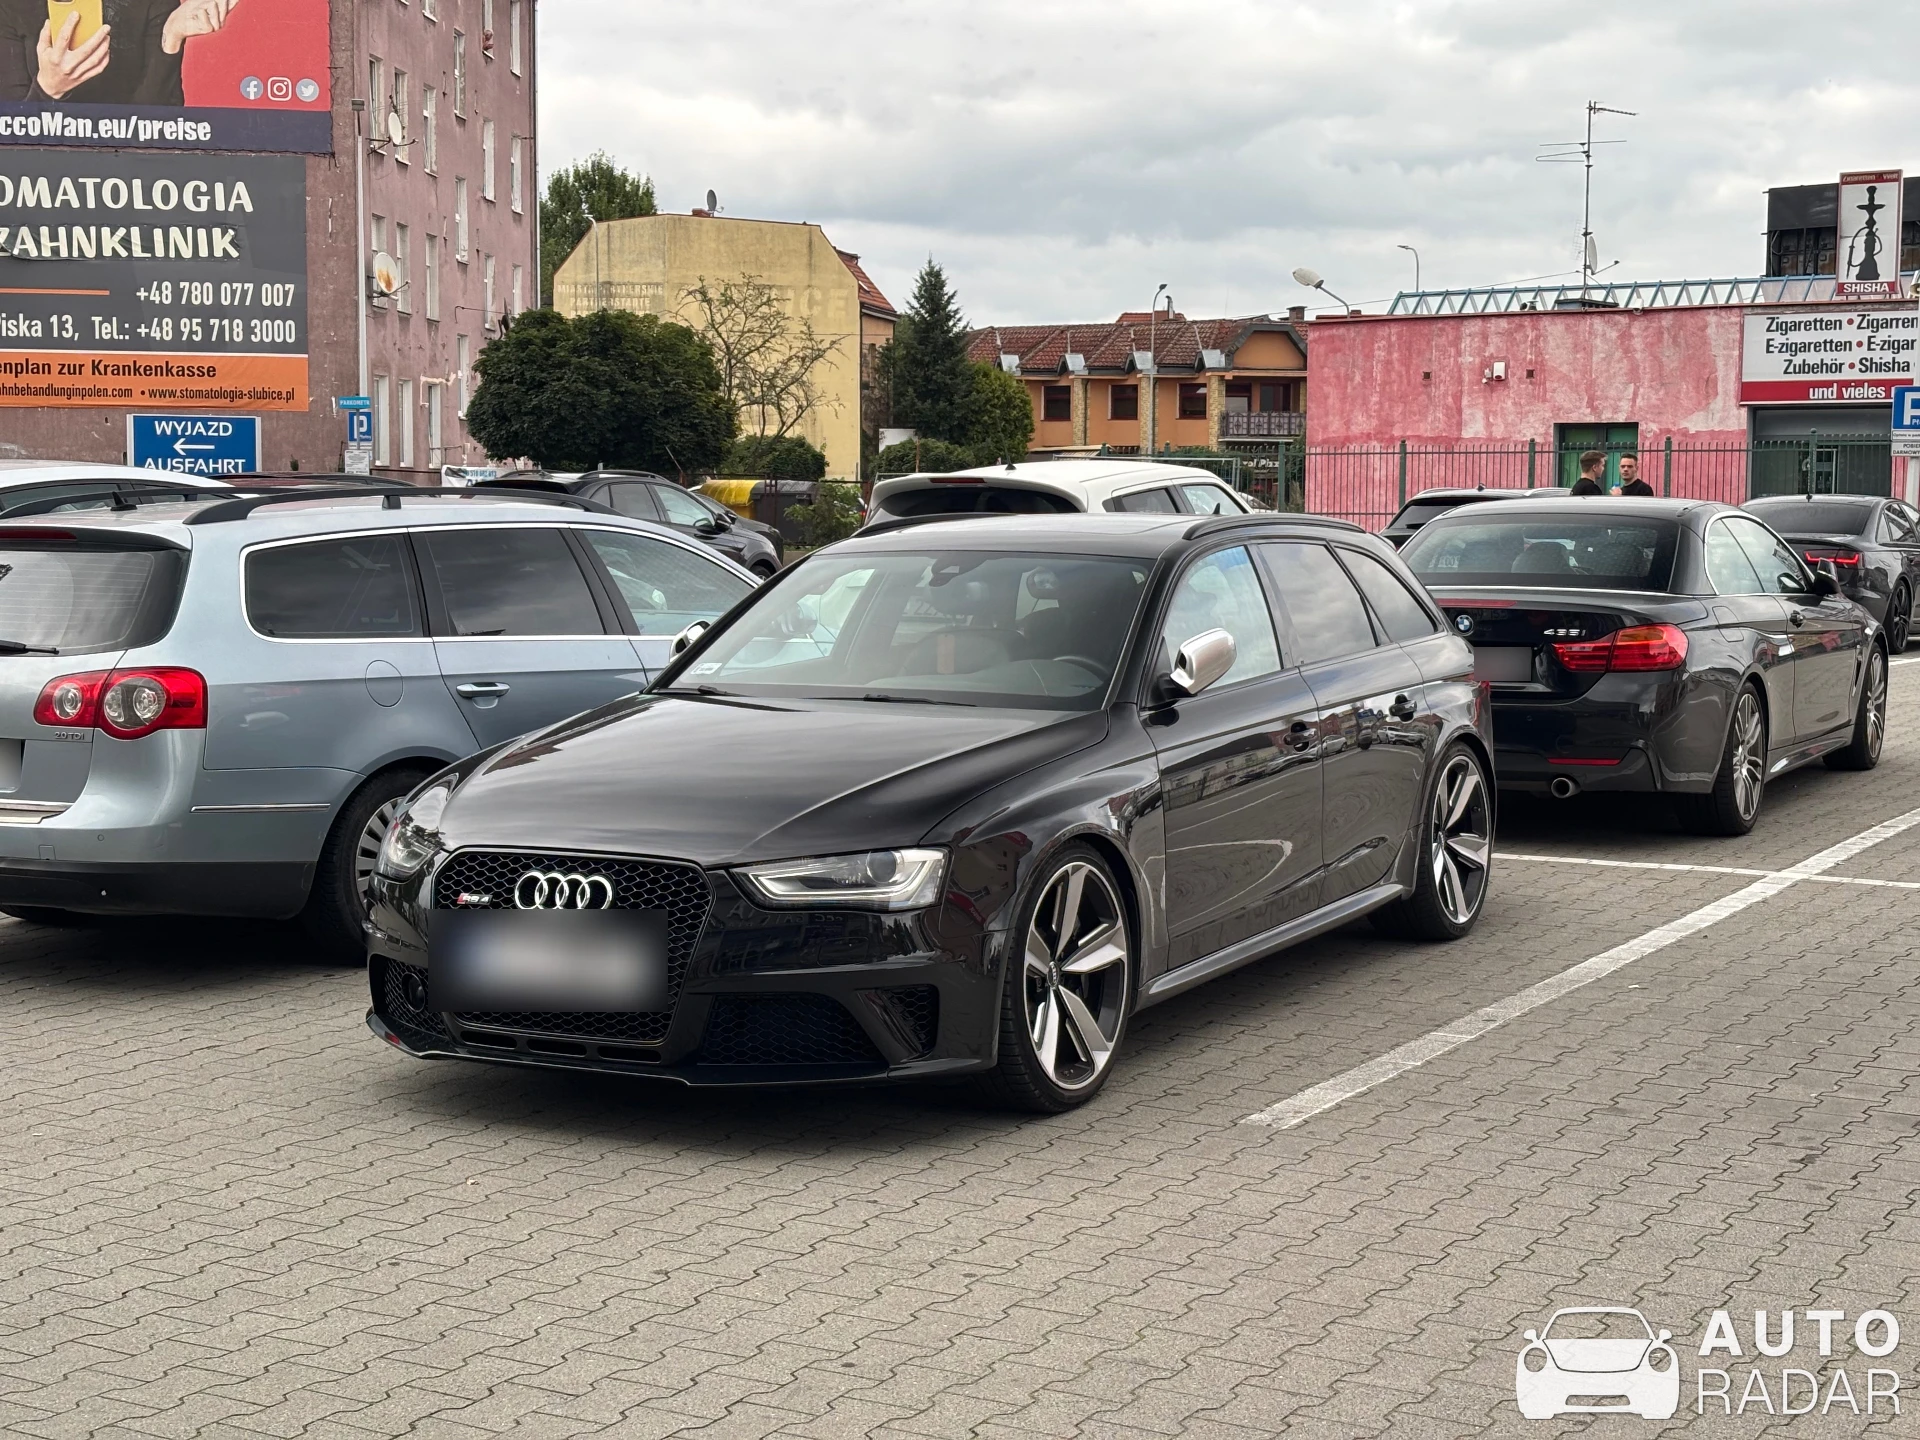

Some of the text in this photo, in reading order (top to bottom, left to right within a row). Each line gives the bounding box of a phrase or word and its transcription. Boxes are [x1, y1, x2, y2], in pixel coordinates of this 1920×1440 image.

[0, 112, 211, 141] ccoMan.eu/preise
[136, 280, 295, 307] +48 780 077 007
[1843, 282, 1890, 293] SHISHA
[0, 312, 296, 343] iska 13, Tel.: +48 95 718 3000
[1766, 313, 1919, 336] Zigaretten Zigarren
[1765, 338, 1853, 357] E-zigaretten
[57, 362, 85, 376] zur
[91, 359, 217, 378] Krankenkasse
[1783, 356, 1911, 375] Zubehör Shisha
[0, 383, 295, 403] hnbehandlunginpolen.com www.stomatologia-slubice.pl
[1809, 383, 1838, 399] und
[1842, 383, 1886, 399] vieles
[154, 420, 233, 436] WYJAZD
[144, 457, 246, 474] AUSFAHRT
[1543, 628, 1586, 636] 435i
